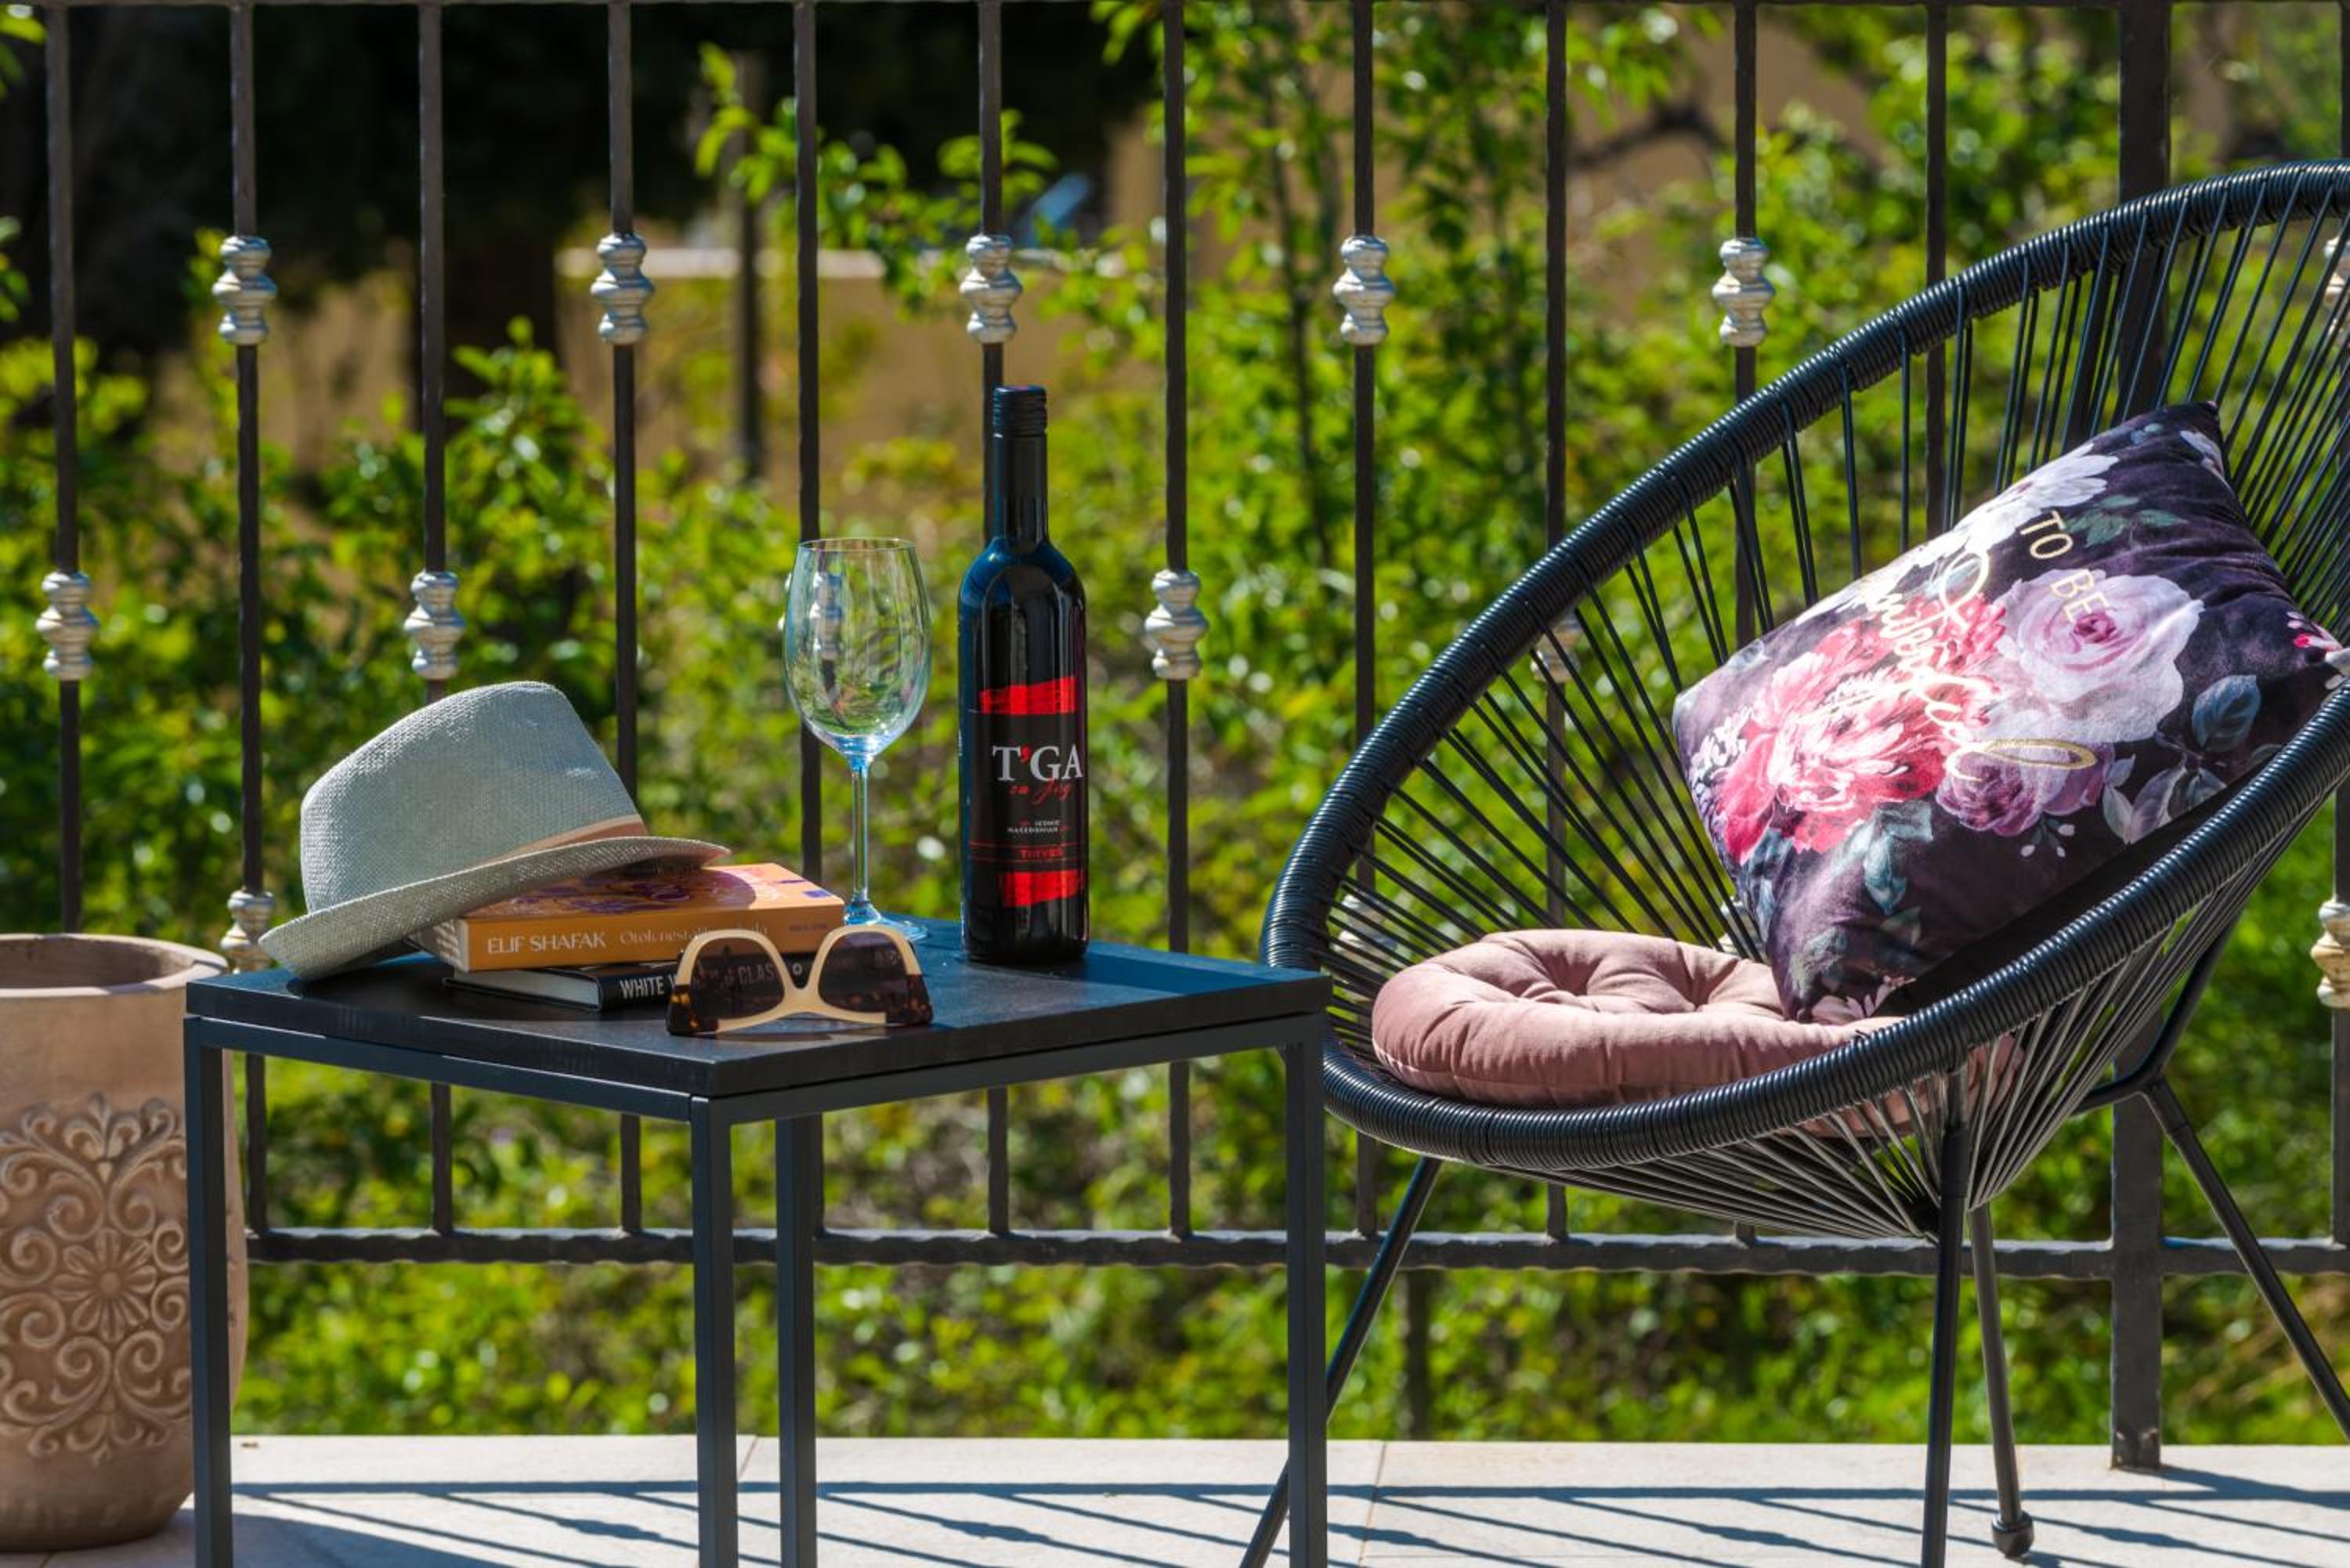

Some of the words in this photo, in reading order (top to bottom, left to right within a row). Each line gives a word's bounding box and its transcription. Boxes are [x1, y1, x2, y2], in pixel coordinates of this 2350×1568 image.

[2019, 510, 2073, 560] TO
[2050, 569, 2109, 623] BE
[487, 935, 525, 954] ELIF
[530, 931, 606, 951] SHAFAK
[620, 976, 665, 1000] WHITE
